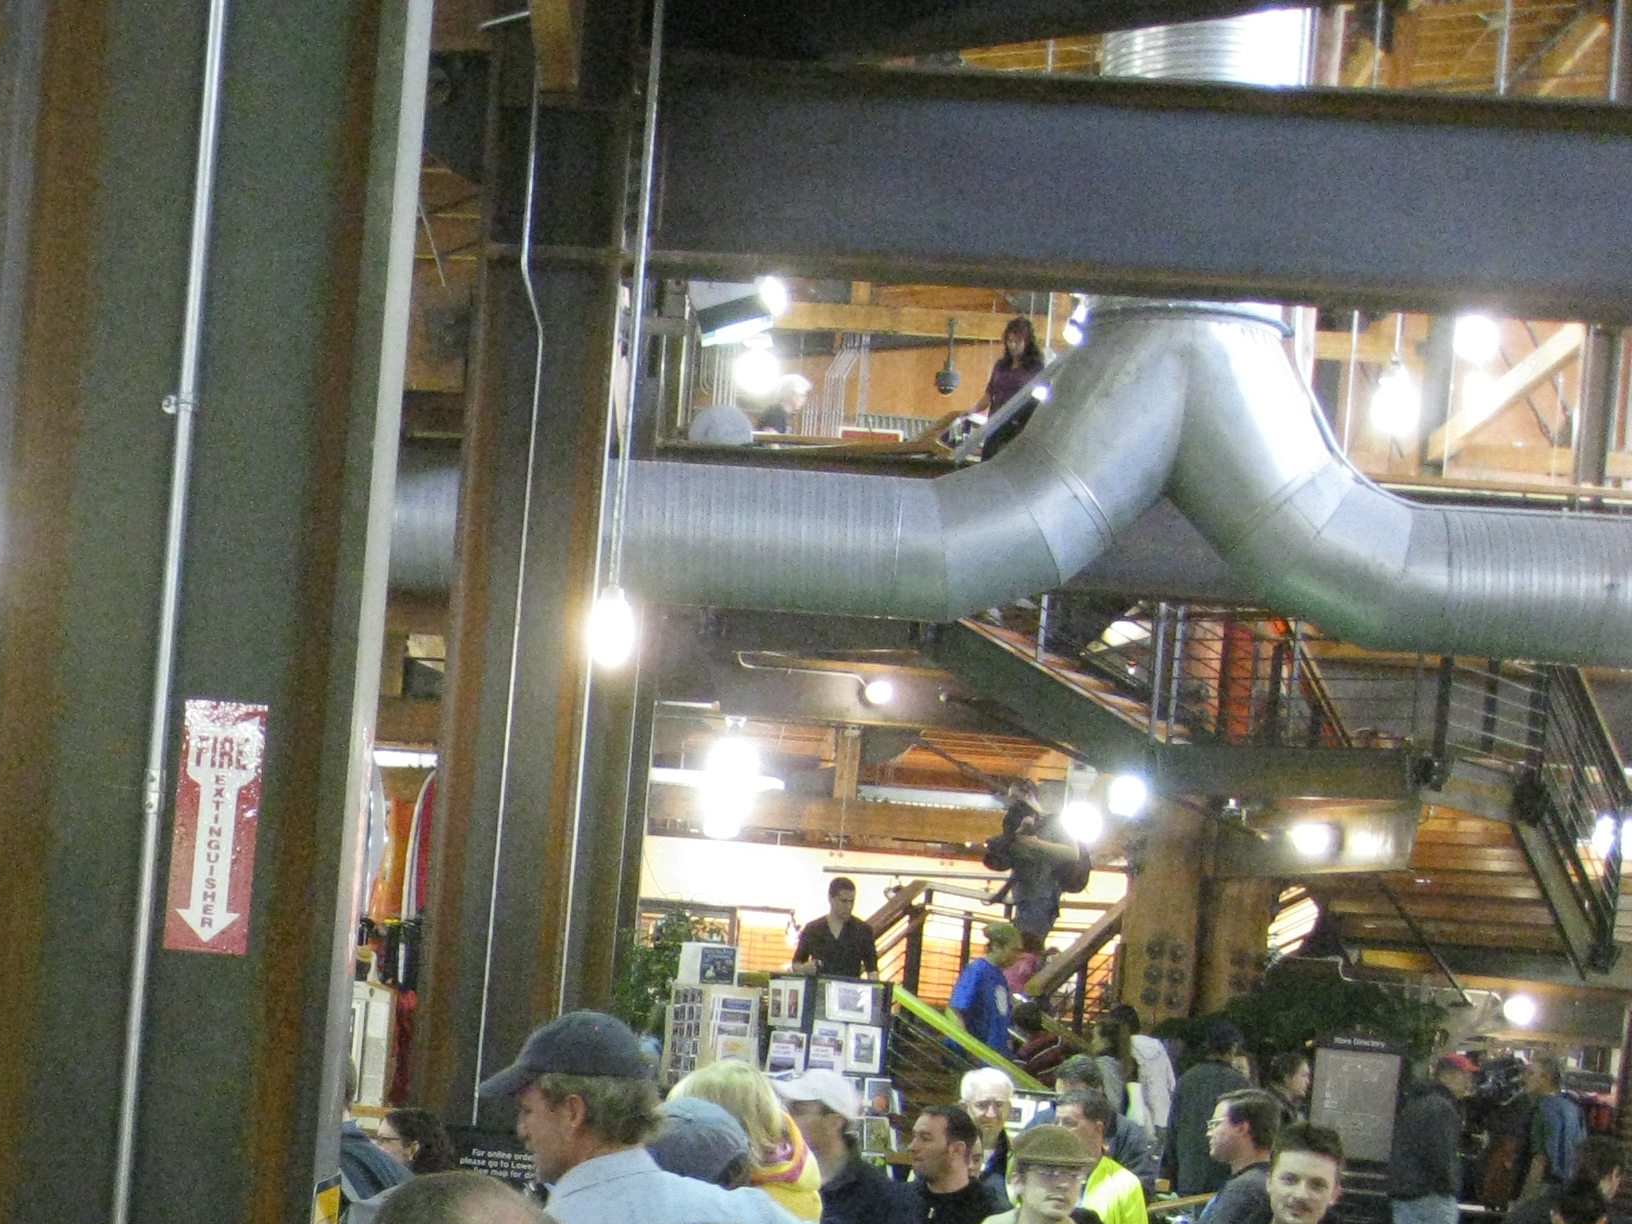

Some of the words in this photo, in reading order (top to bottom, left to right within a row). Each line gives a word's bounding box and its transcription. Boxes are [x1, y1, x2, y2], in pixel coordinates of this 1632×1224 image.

[195, 736, 250, 770] FIRE
[200, 774, 227, 928] EXTINGUISHER
[472, 1148, 486, 1157] For
[488, 1150, 512, 1160] online
[460, 1157, 486, 1166] please
[488, 1160, 498, 1168] go
[500, 1160, 509, 1169] to
[510, 1170, 522, 1179] for
